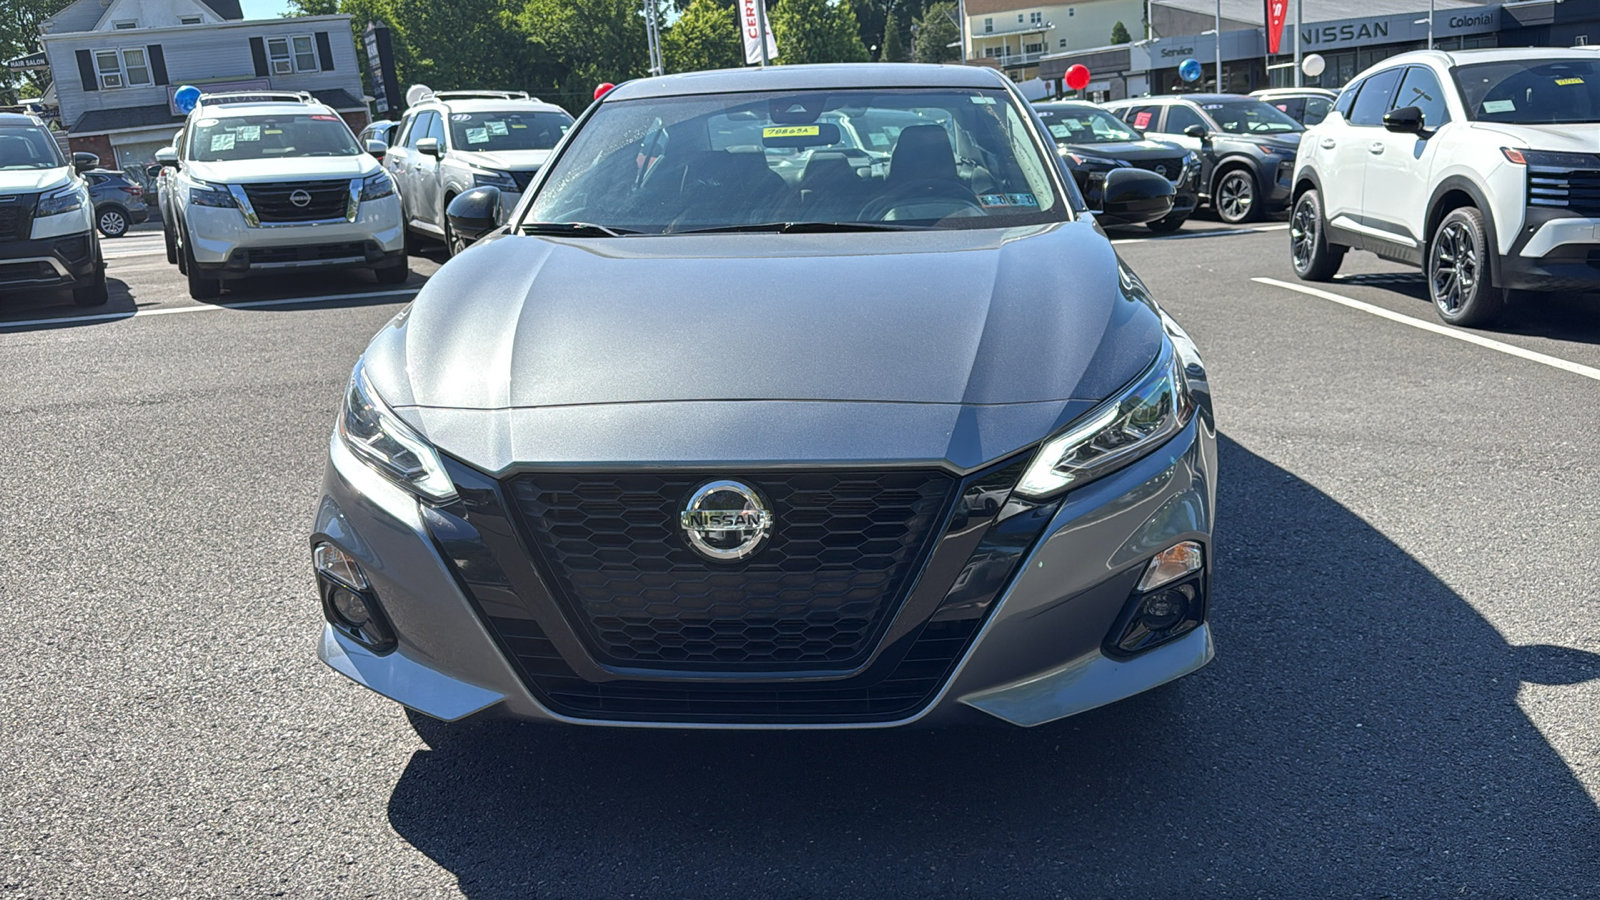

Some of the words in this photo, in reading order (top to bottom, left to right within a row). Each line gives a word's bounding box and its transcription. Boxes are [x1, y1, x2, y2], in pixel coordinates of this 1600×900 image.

[1449, 14, 1493, 29] Colonial
[1302, 21, 1389, 45] NISSAN
[1161, 46, 1194, 58] Service
[10, 60, 25, 68] HAIR
[25, 58, 46, 66] SALON
[690, 514, 761, 527] NISSAN
